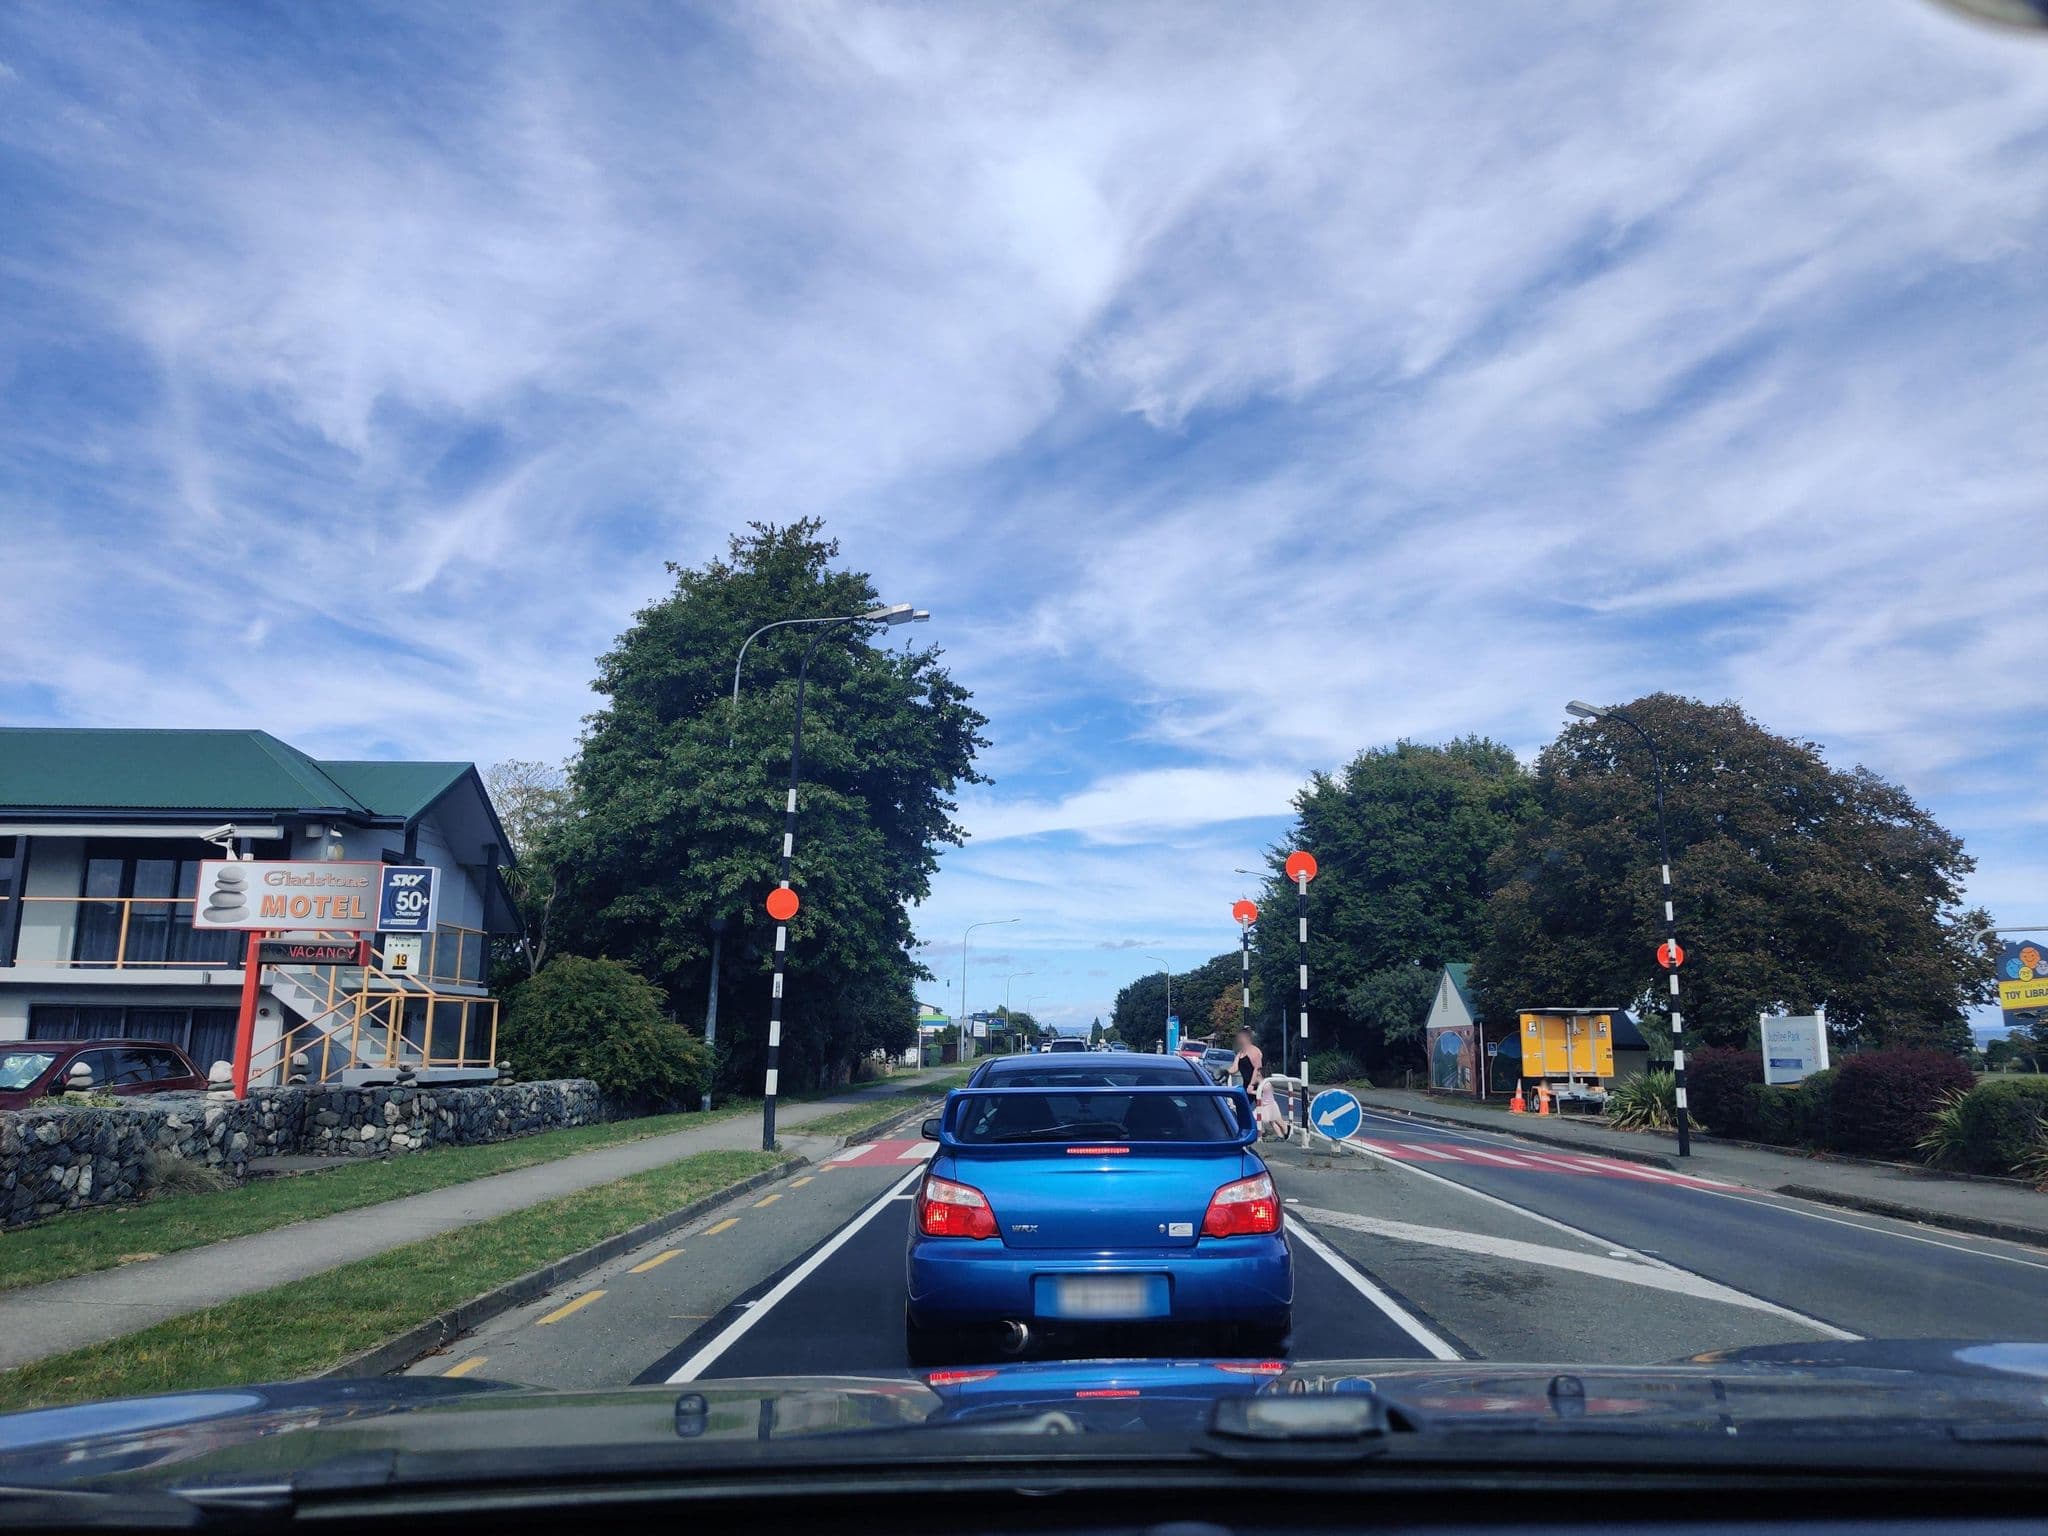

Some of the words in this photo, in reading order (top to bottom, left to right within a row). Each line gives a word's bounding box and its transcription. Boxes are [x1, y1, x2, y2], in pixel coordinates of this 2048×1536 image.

[264, 870, 369, 888] Gladstone
[389, 873, 425, 887] SKY
[260, 895, 367, 919] MOTEL
[395, 890, 429, 912] 50+
[289, 946, 356, 960] VACANCY
[396, 953, 408, 966] 19
[2004, 991, 2021, 1000] TOY
[1011, 1224, 1039, 1233] WRX
